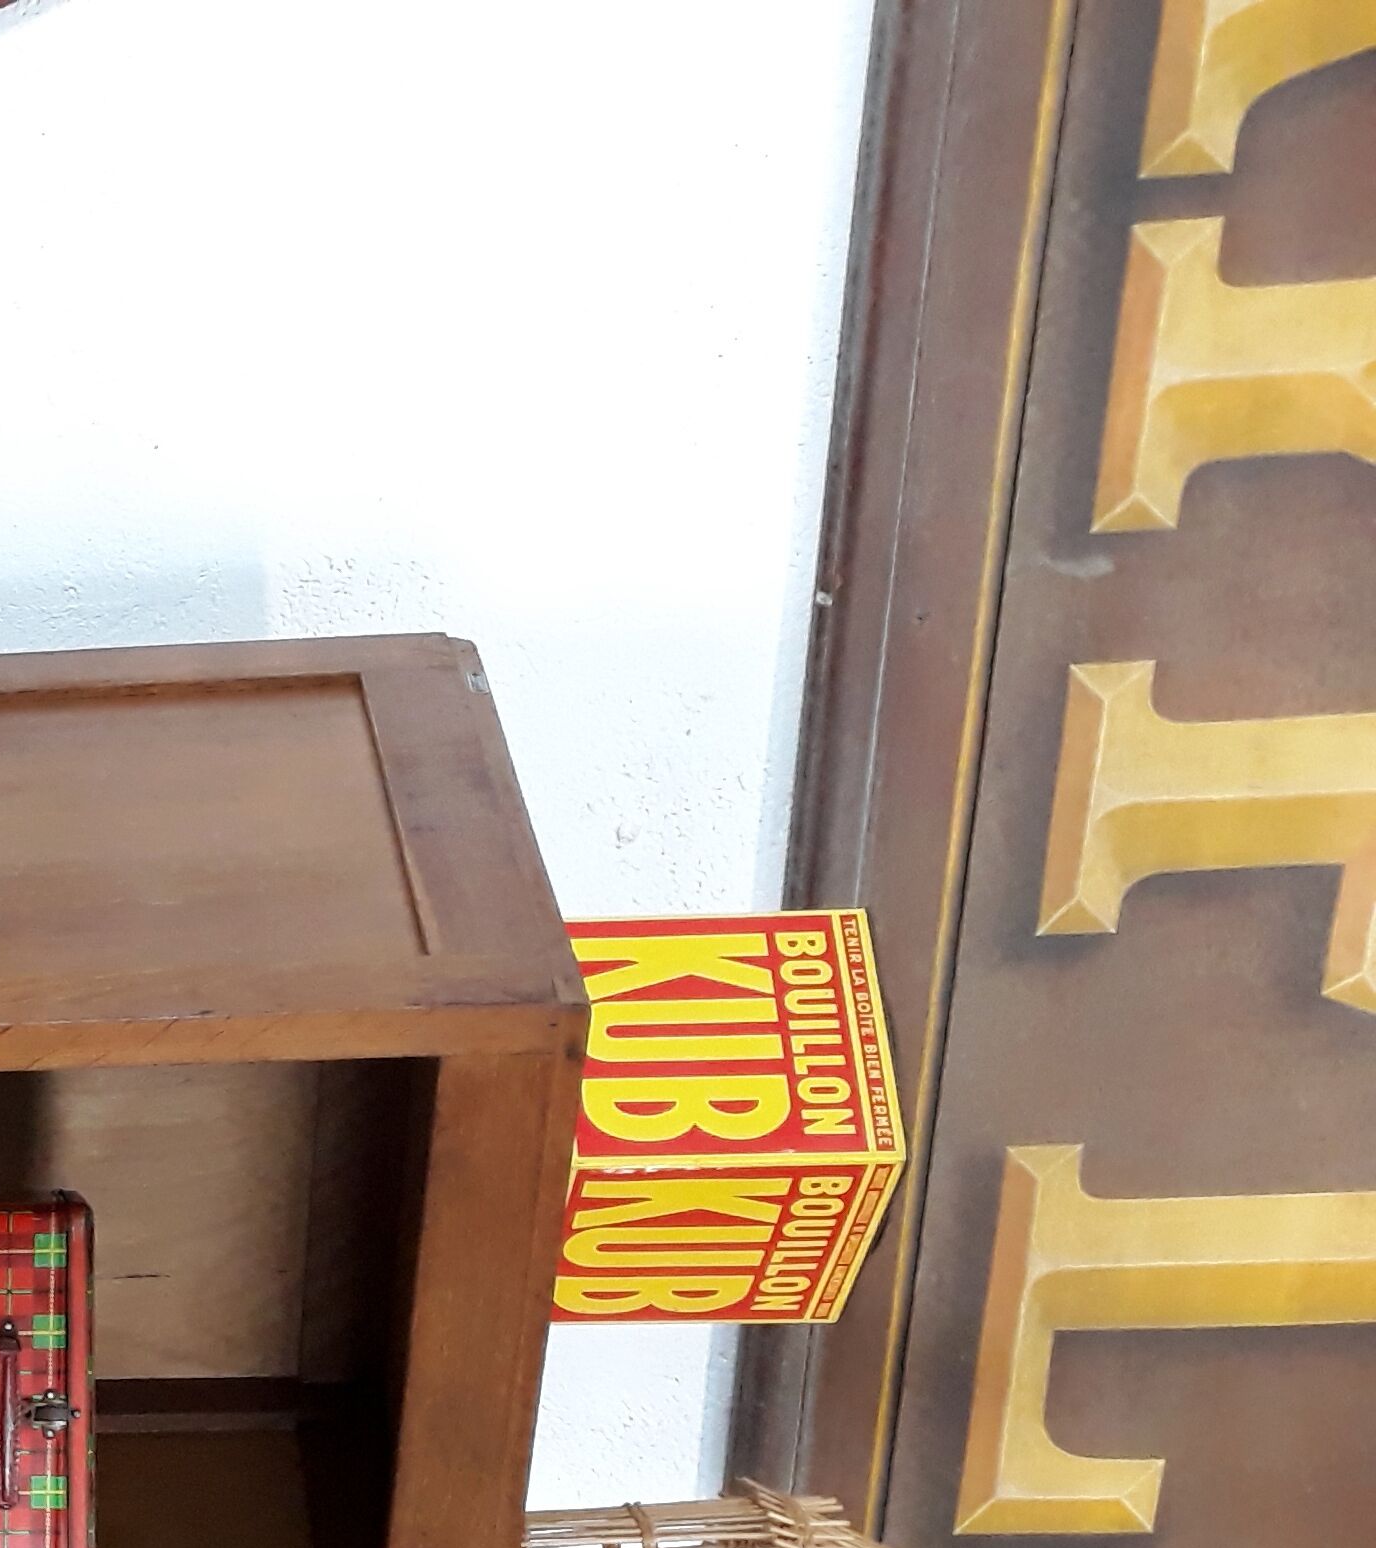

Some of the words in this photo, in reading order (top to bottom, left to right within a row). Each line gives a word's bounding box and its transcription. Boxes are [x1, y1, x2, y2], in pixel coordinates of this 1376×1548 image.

[843, 918, 863, 964] TENIR
[851, 968, 866, 986] LA
[569, 933, 792, 1142] KUB
[774, 930, 857, 1135] BOUILLON
[864, 1044, 883, 1079] BIEN
[871, 1086, 894, 1148] FERMÉE
[552, 1178, 793, 1315] KUB
[749, 1176, 854, 1311] BOUILLON
